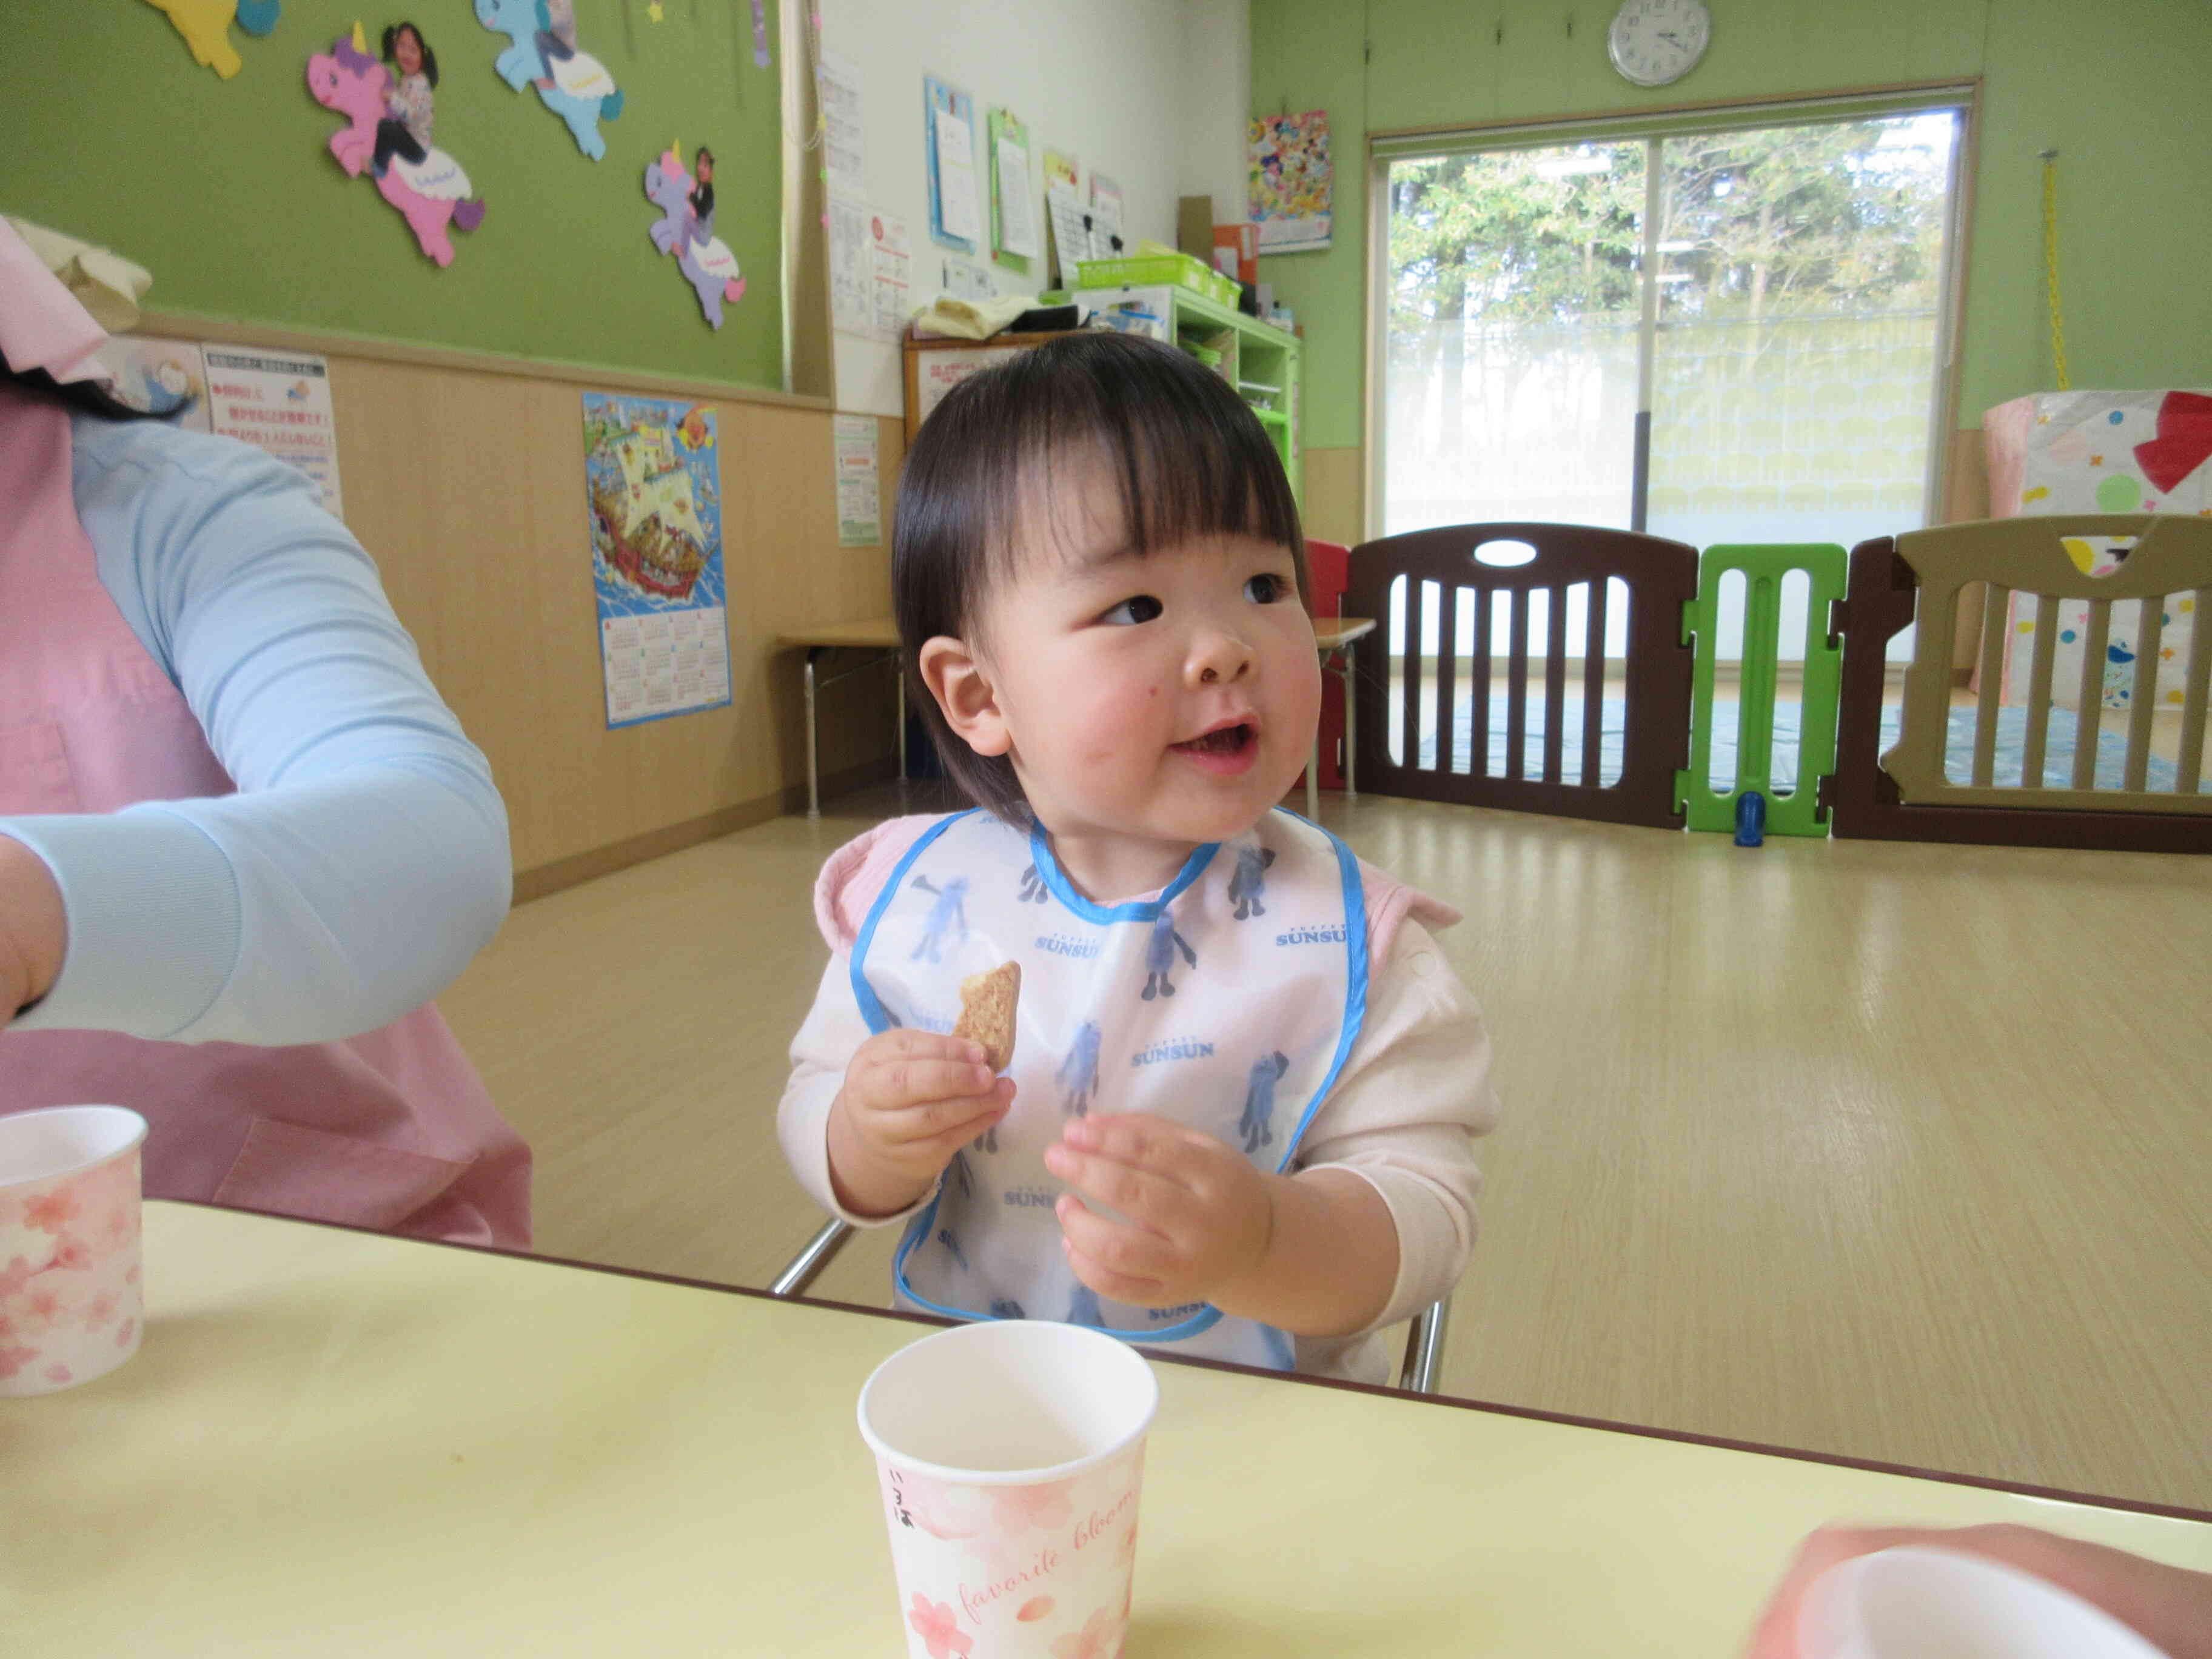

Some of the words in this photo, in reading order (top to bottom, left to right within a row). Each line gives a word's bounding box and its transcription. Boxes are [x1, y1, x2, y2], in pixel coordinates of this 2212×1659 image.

[1034, 936, 1102, 959] SUNSU
[1276, 930, 1347, 946] SUNSU
[1130, 1042, 1215, 1067] SUNSUN
[1004, 1191, 1056, 1207] SUN
[958, 1547, 1059, 1625] favorite
